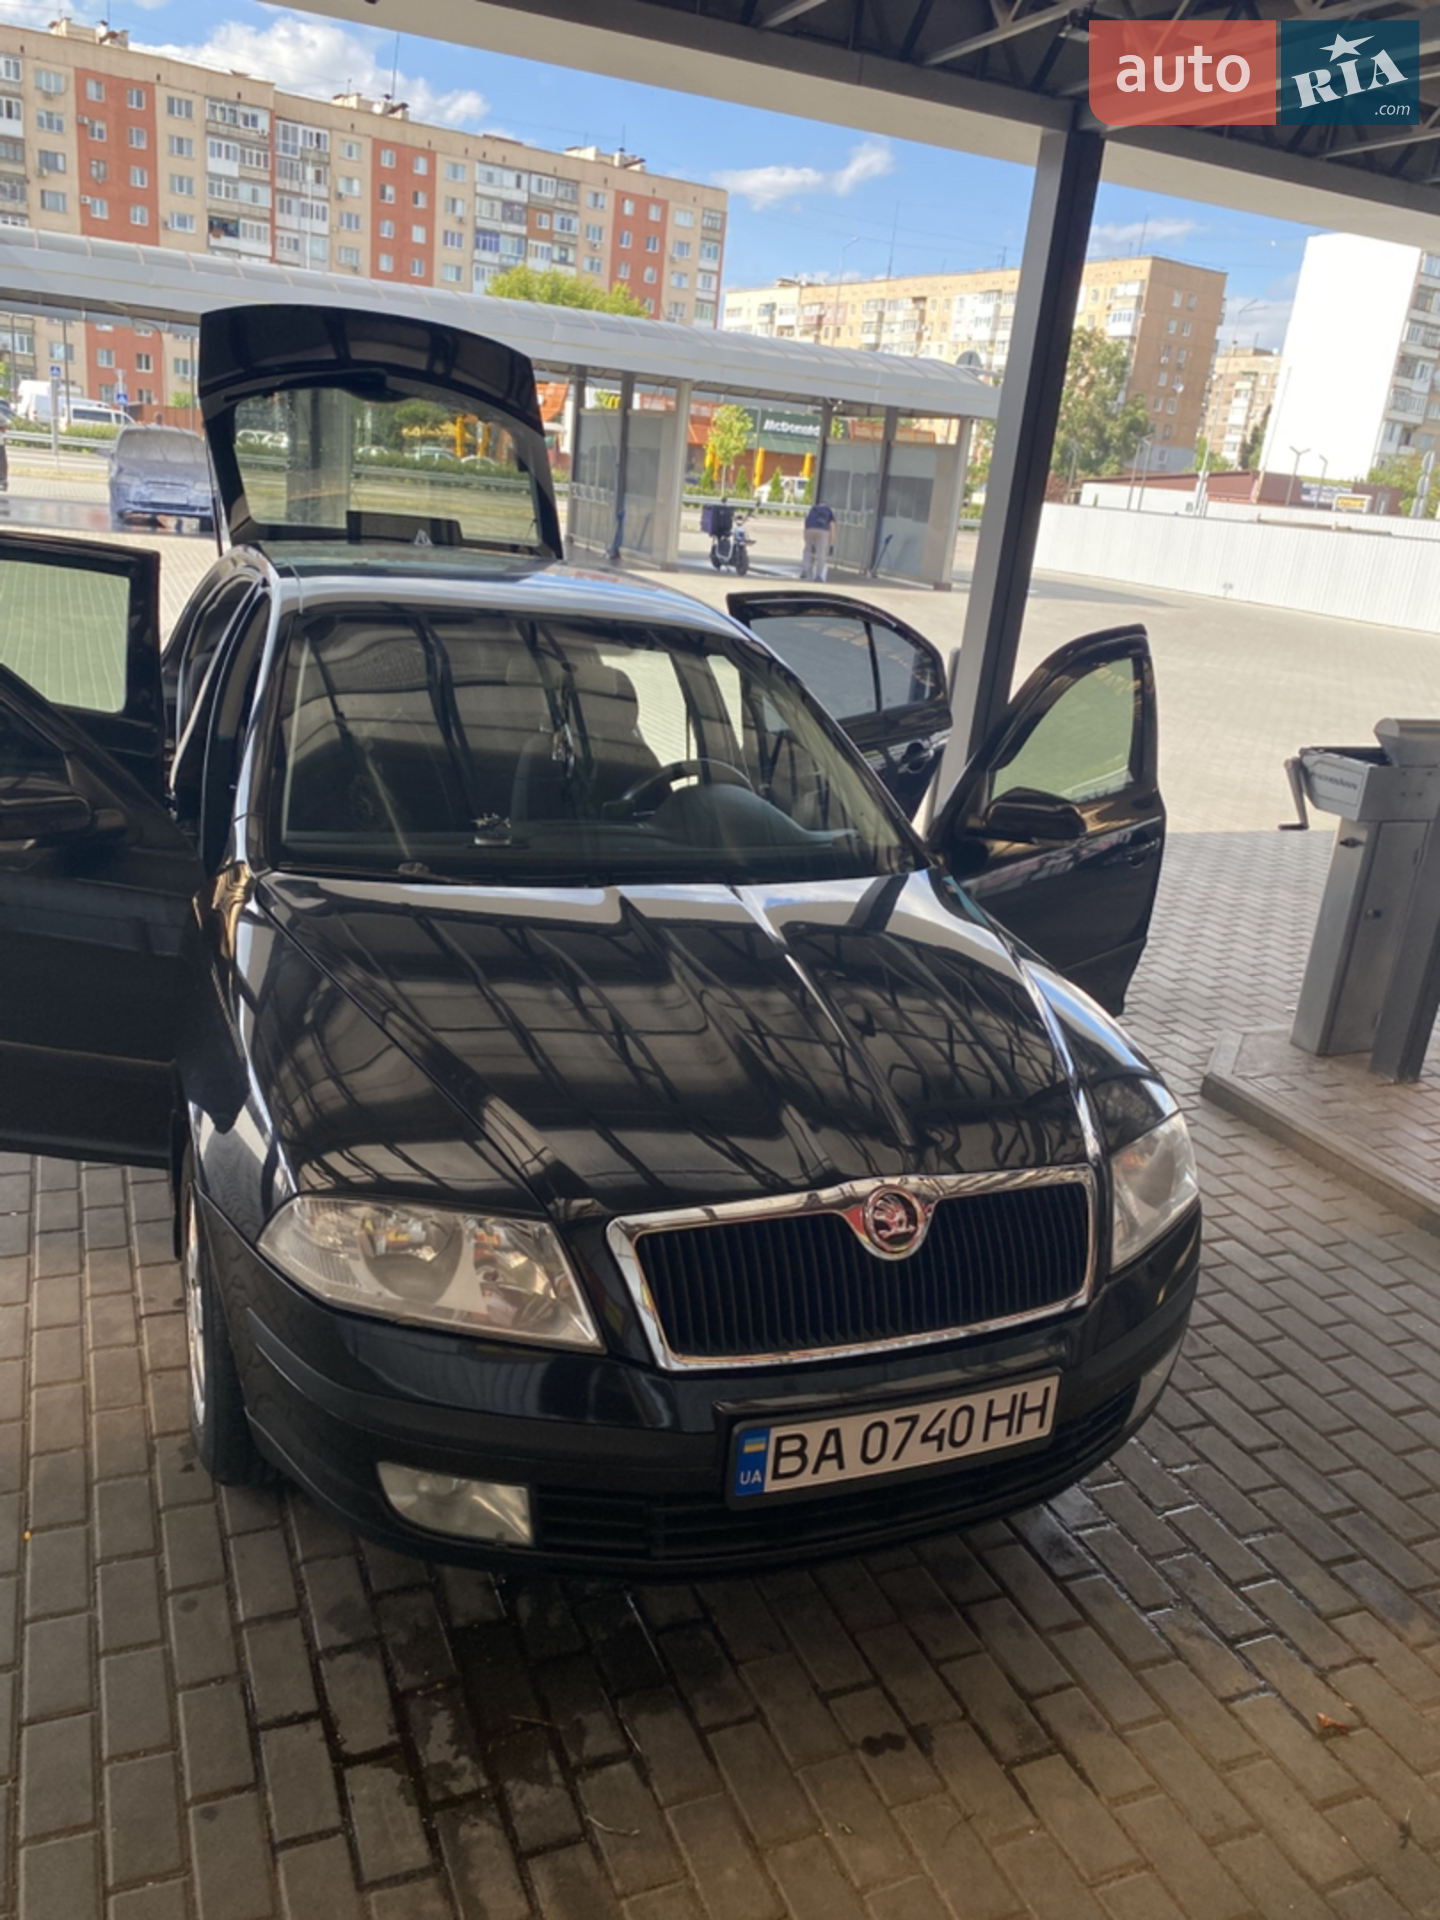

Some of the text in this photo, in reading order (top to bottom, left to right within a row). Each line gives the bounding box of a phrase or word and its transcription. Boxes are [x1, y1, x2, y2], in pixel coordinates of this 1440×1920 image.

[763, 418, 821, 437] McDonald
[770, 1386, 1052, 1482] BA 0740 HH
[739, 1469, 762, 1486] UA
